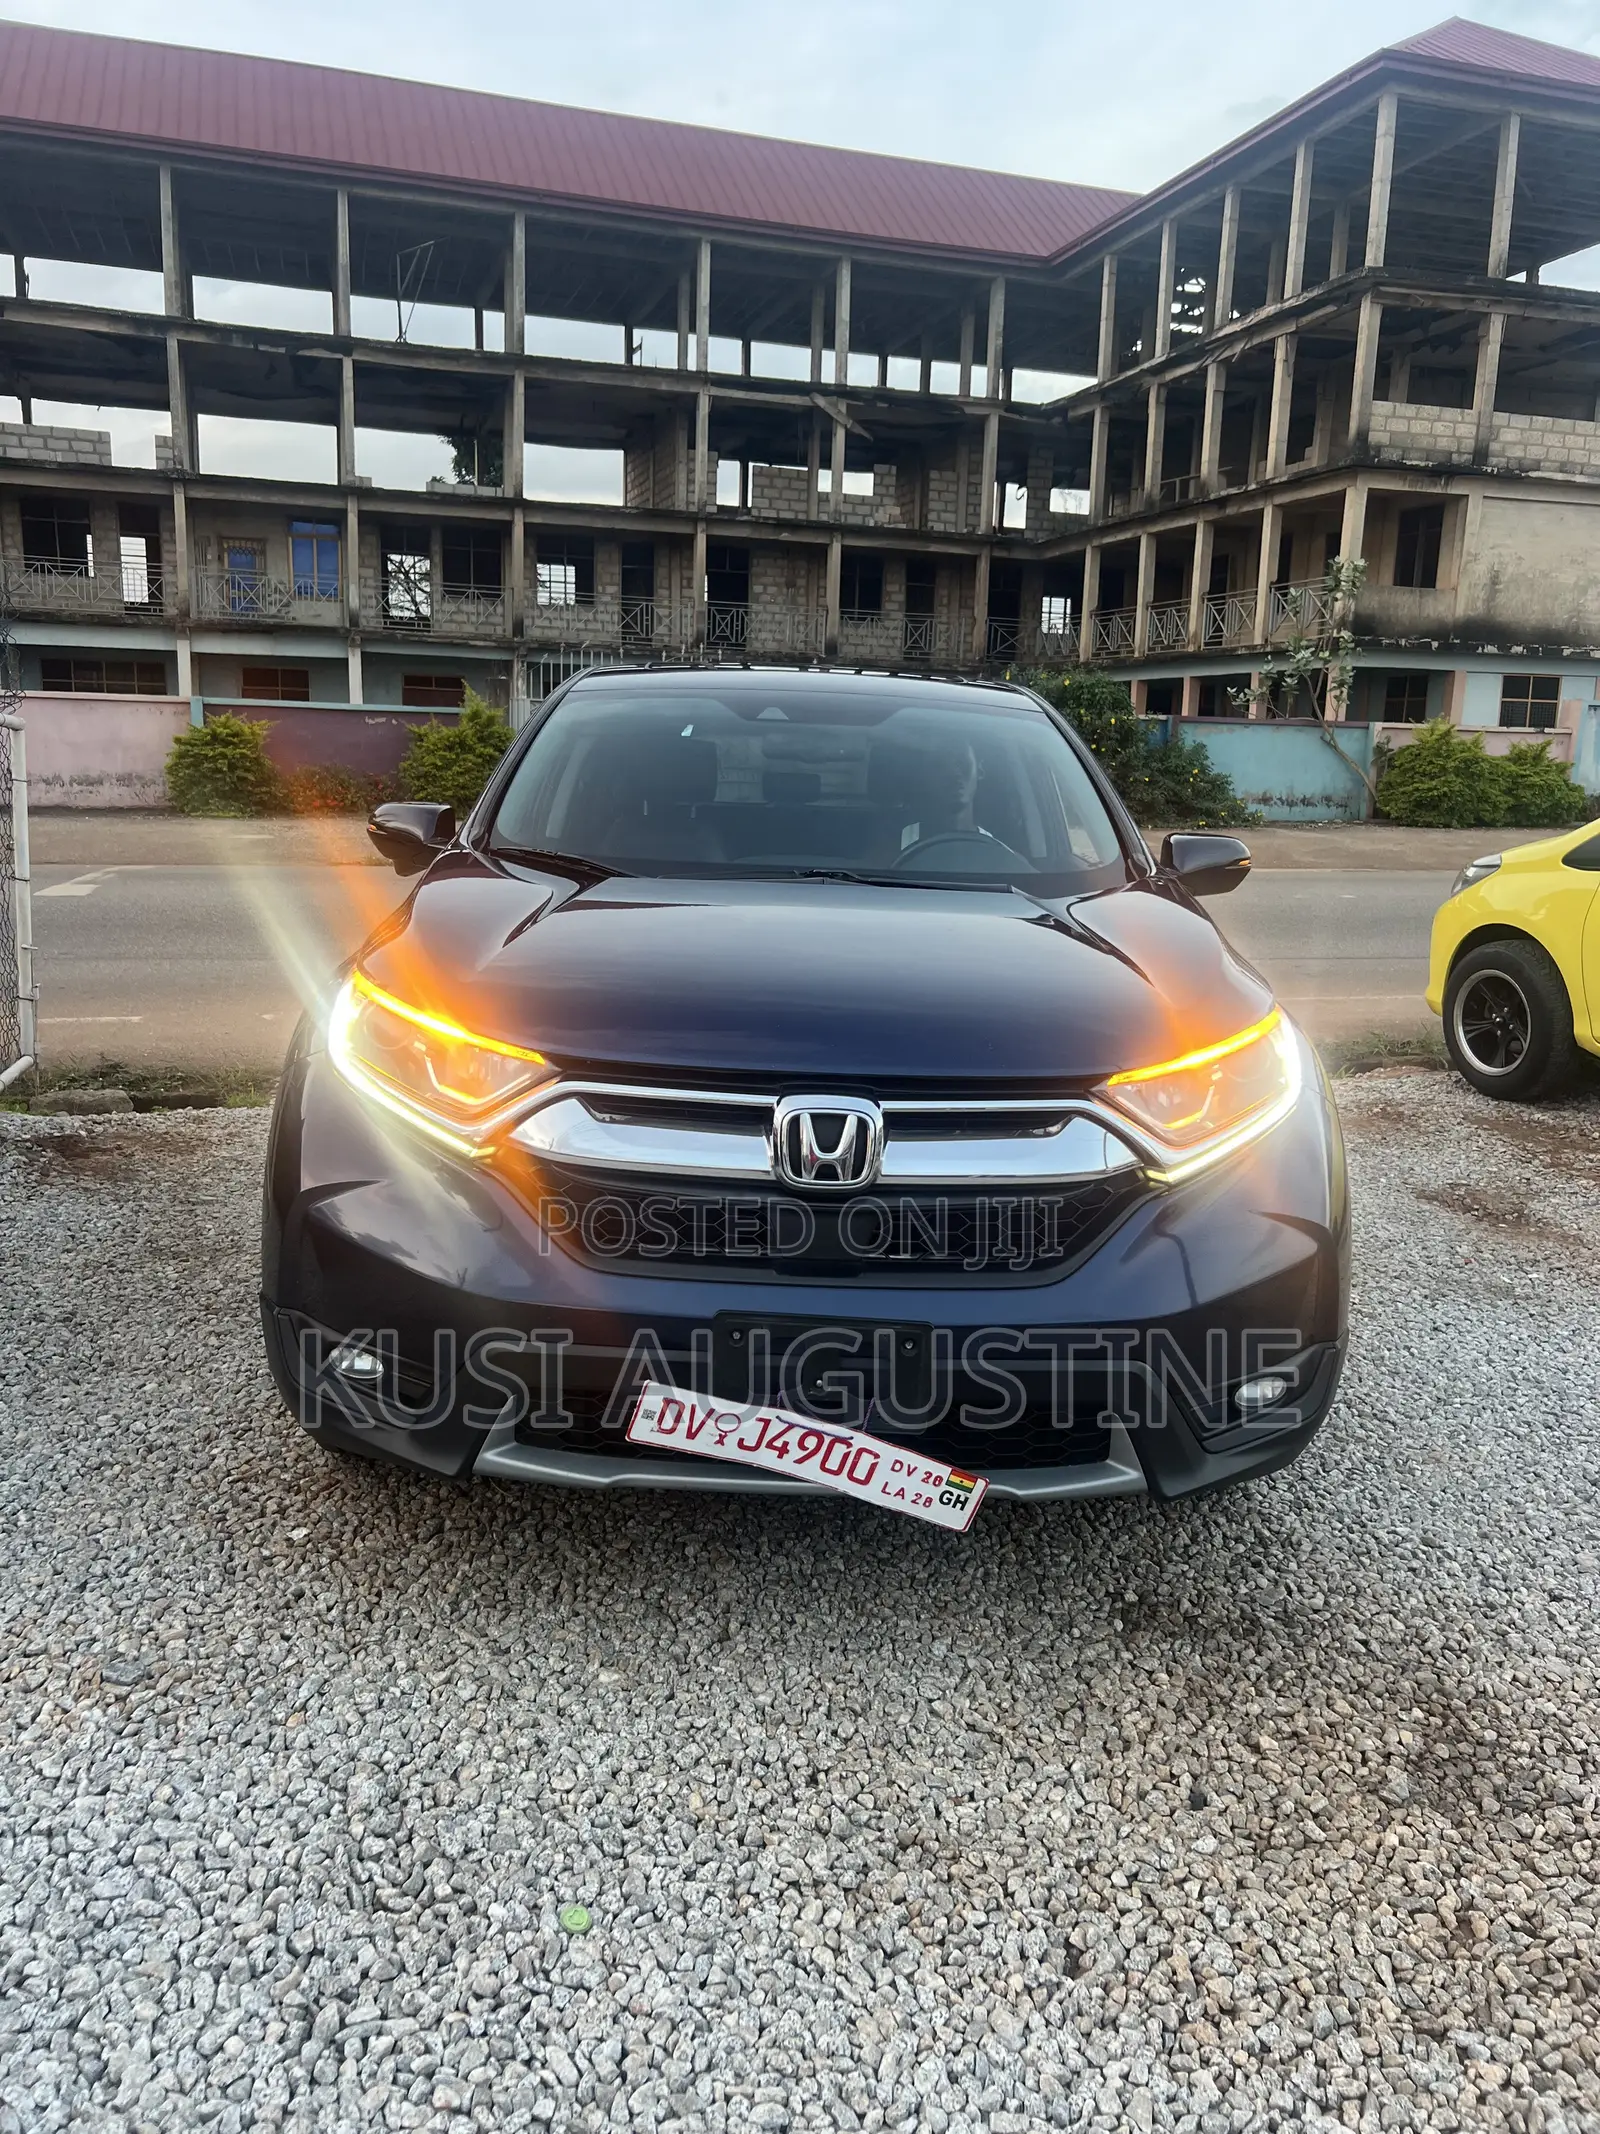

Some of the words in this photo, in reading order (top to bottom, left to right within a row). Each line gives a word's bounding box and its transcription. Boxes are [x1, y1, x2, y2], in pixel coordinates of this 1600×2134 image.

[656, 1397, 716, 1441] DV
[736, 1417, 881, 1486] J4900
[890, 1459, 918, 1477] DV
[880, 1481, 905, 1500] LA
[938, 1490, 970, 1512] GH
